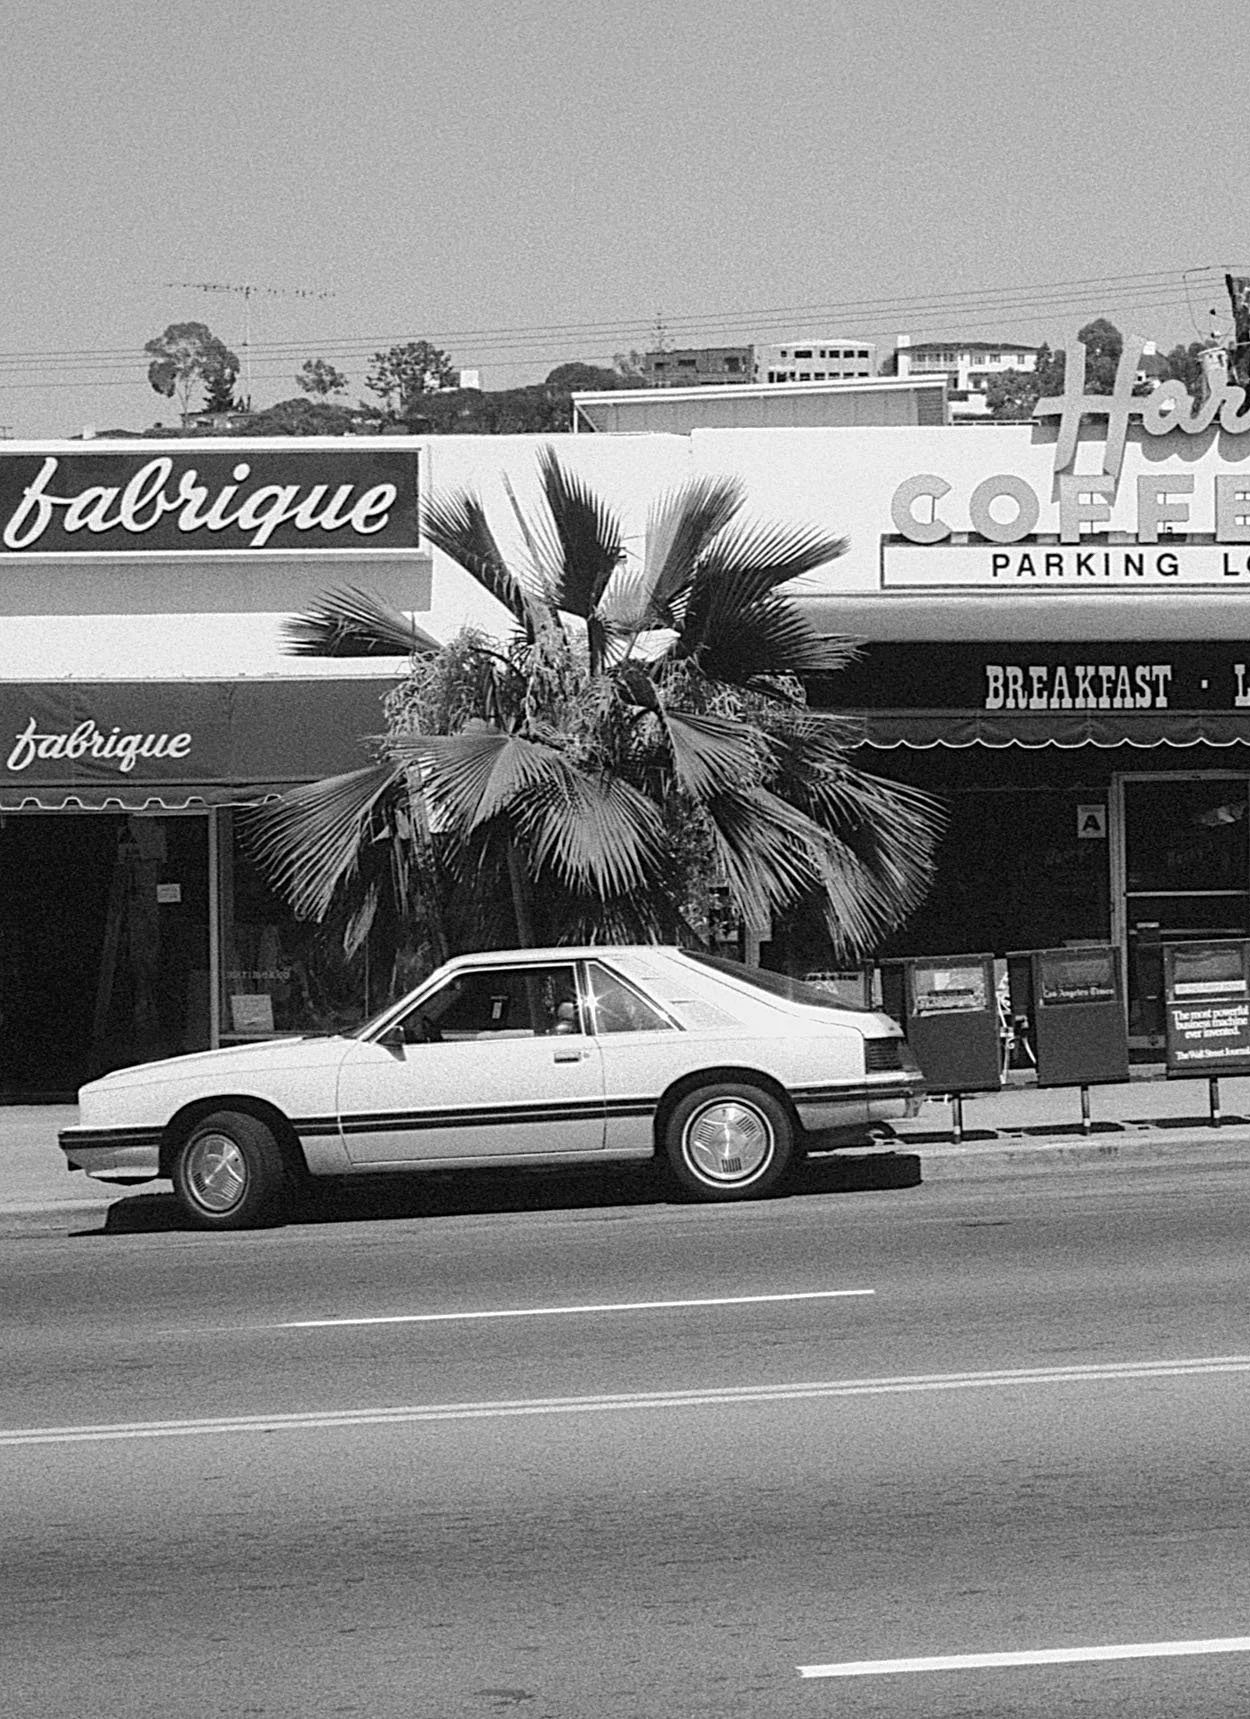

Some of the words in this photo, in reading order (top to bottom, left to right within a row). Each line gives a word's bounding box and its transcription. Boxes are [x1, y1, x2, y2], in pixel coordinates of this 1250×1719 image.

[3, 457, 397, 549] fabrique
[992, 552, 1180, 577] PARKING
[985, 664, 1172, 709] BREAKFAST
[7, 717, 192, 772] fabrique
[1082, 814, 1101, 831] A
[1171, 1010, 1190, 1021] The
